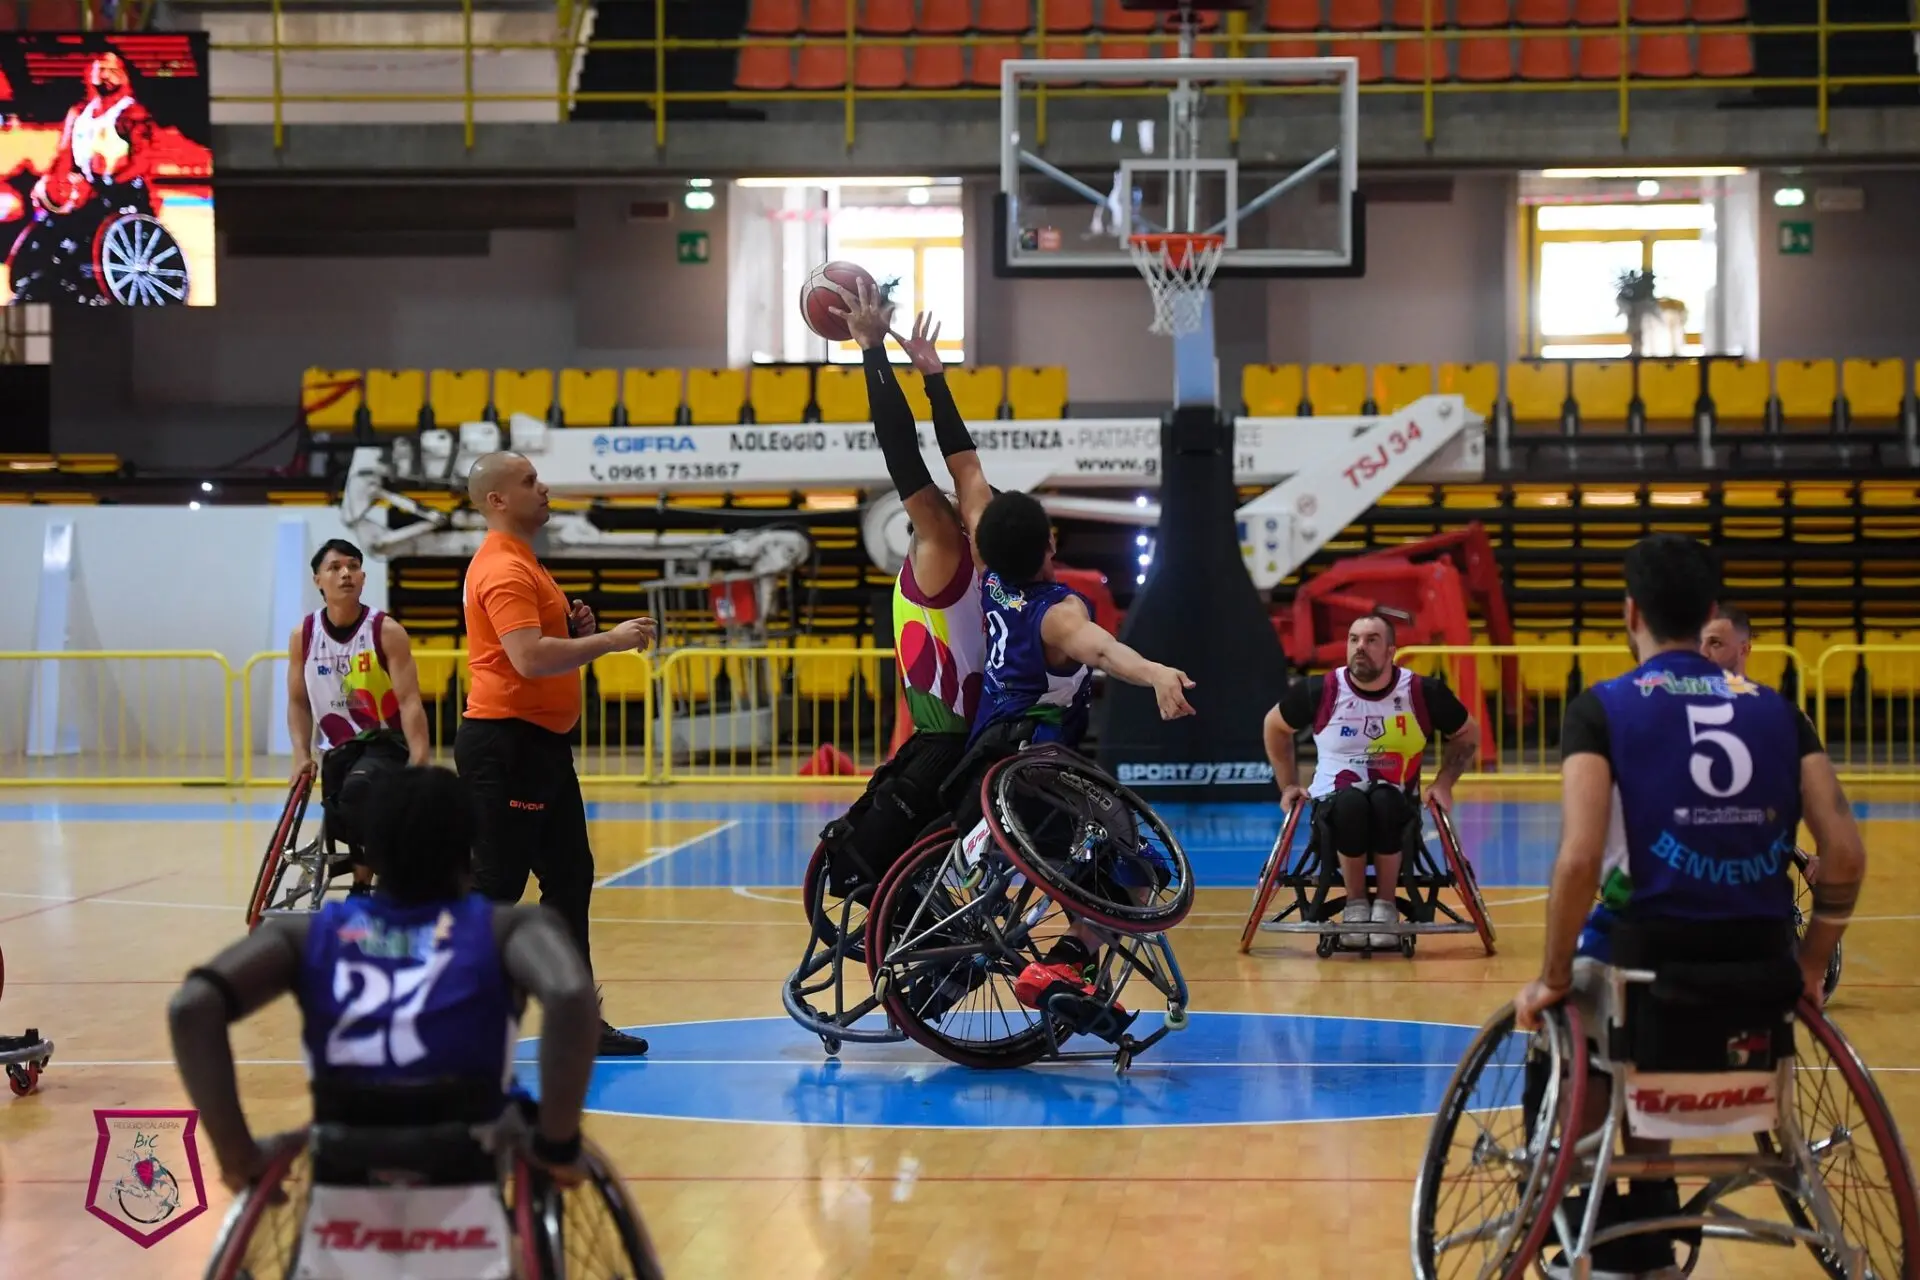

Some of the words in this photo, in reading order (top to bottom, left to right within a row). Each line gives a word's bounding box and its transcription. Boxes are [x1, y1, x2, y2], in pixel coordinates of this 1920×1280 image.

[613, 436, 696, 453] GIFRA
[730, 431, 826, 451] NOLEGGIO
[1344, 445, 1389, 488] TSJ
[1389, 420, 1422, 454] 34
[608, 465, 657, 480] 0961
[666, 462, 741, 480] 753867
[1395, 715, 1407, 737] 9
[1685, 702, 1753, 798] 5
[1651, 829, 1794, 885] BENVENUT
[325, 950, 455, 1068] 27
